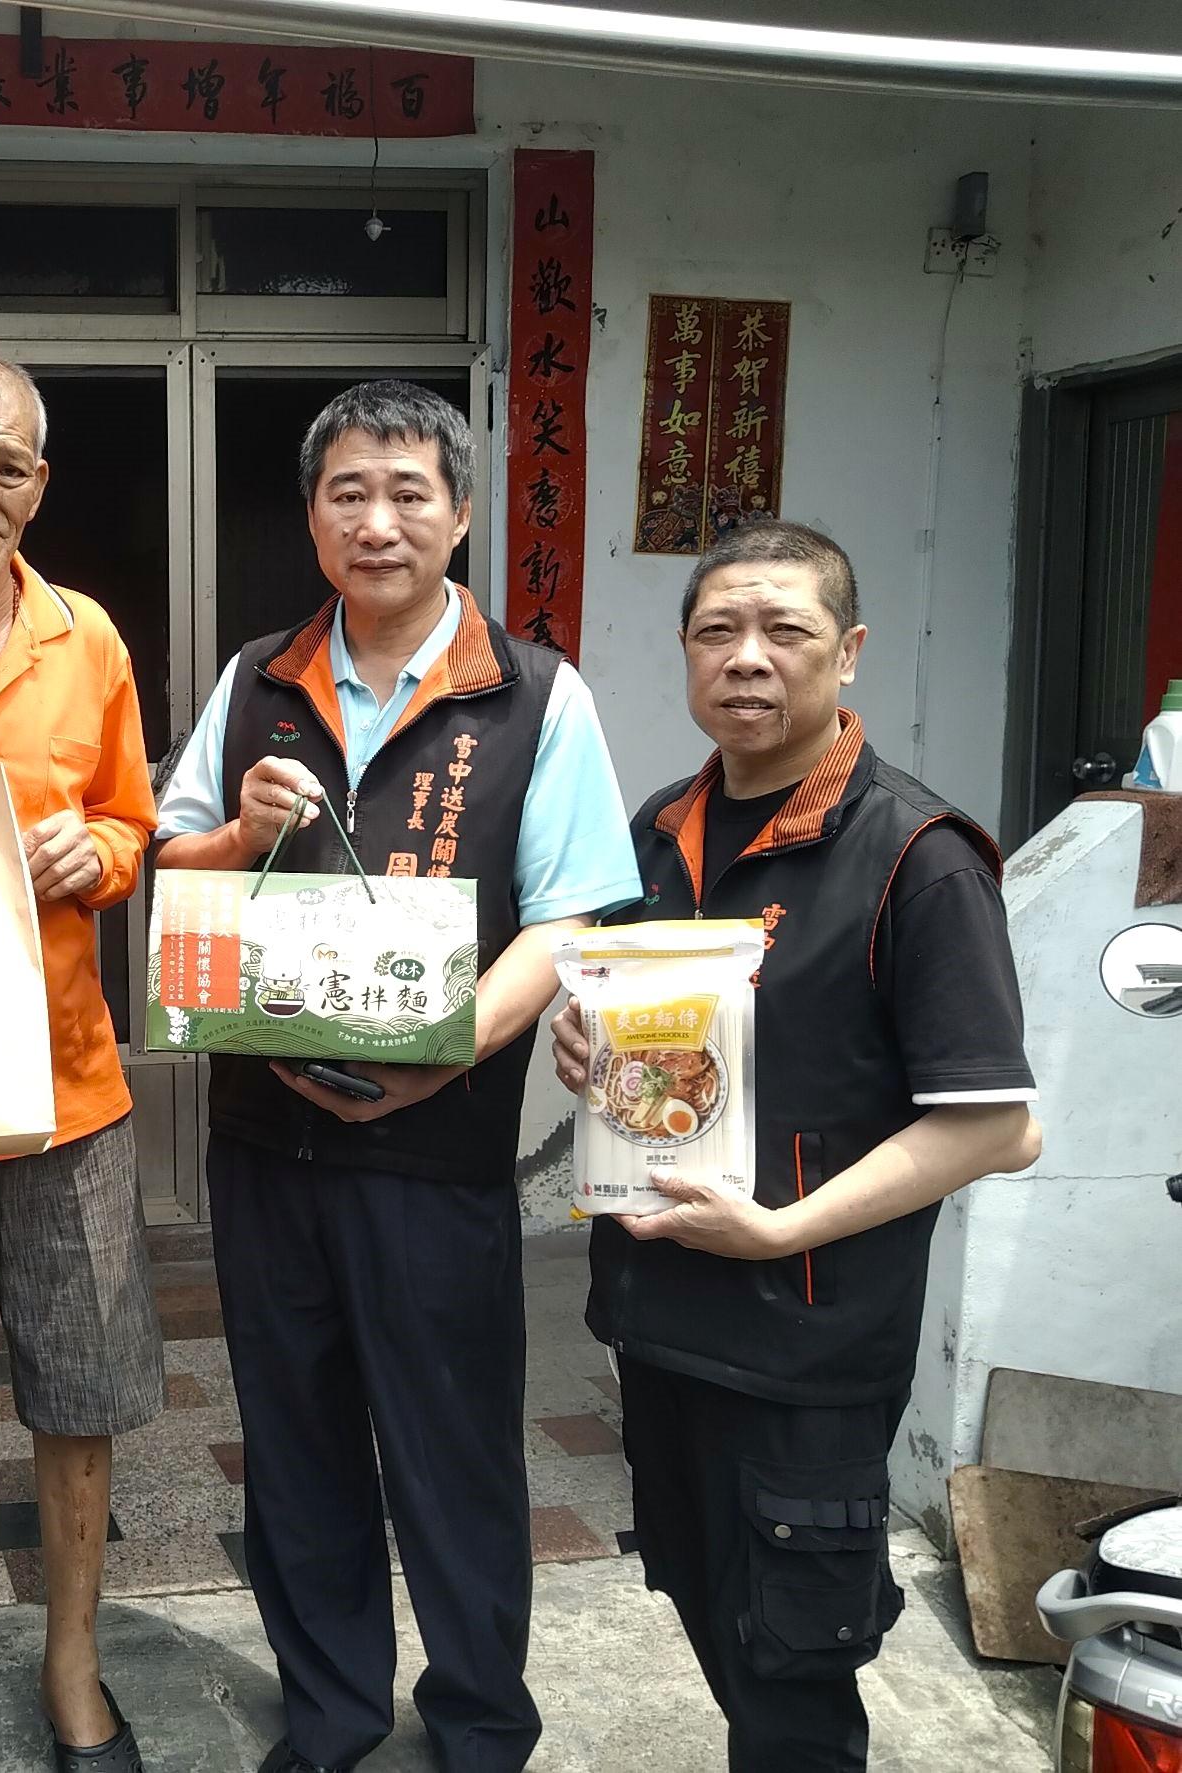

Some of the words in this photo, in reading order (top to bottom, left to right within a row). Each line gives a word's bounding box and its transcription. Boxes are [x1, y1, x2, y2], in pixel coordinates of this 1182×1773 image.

[658, 302, 704, 485] 萬事如意
[723, 308, 773, 489] 恭賀新禧
[407, 772, 435, 831] 理事長
[318, 969, 428, 1015] 憲拌麵
[659, 1031, 690, 1039] NOODLES
